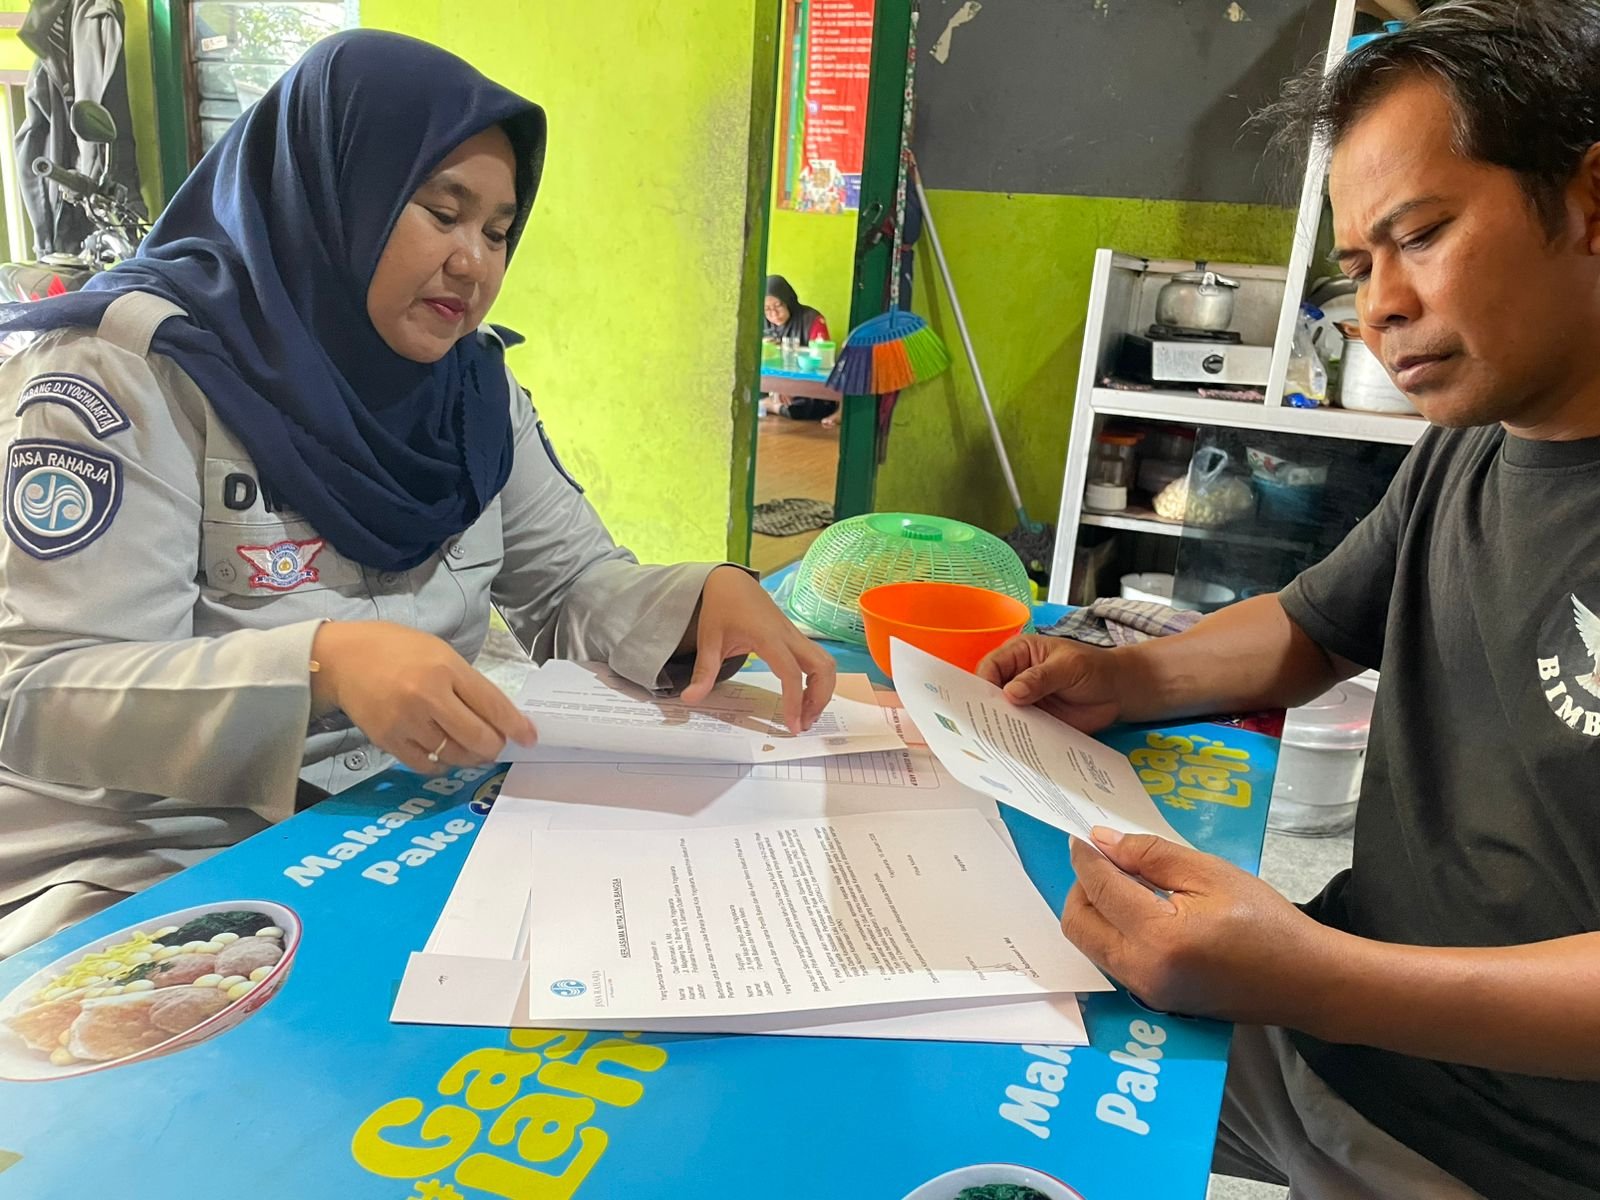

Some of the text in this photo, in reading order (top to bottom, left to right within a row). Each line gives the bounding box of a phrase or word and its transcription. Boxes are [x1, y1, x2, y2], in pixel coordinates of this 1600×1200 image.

[66, 384, 116, 430] YOGYAKARTA
[12, 451, 110, 485] JASA RAHARJA
[283, 797, 437, 888] Makan
[361, 818, 475, 886] Pake
[611, 878, 628, 957] KERJASAMA MITRA PUTRA BANGSA
[1095, 1019, 1167, 1136] Pake
